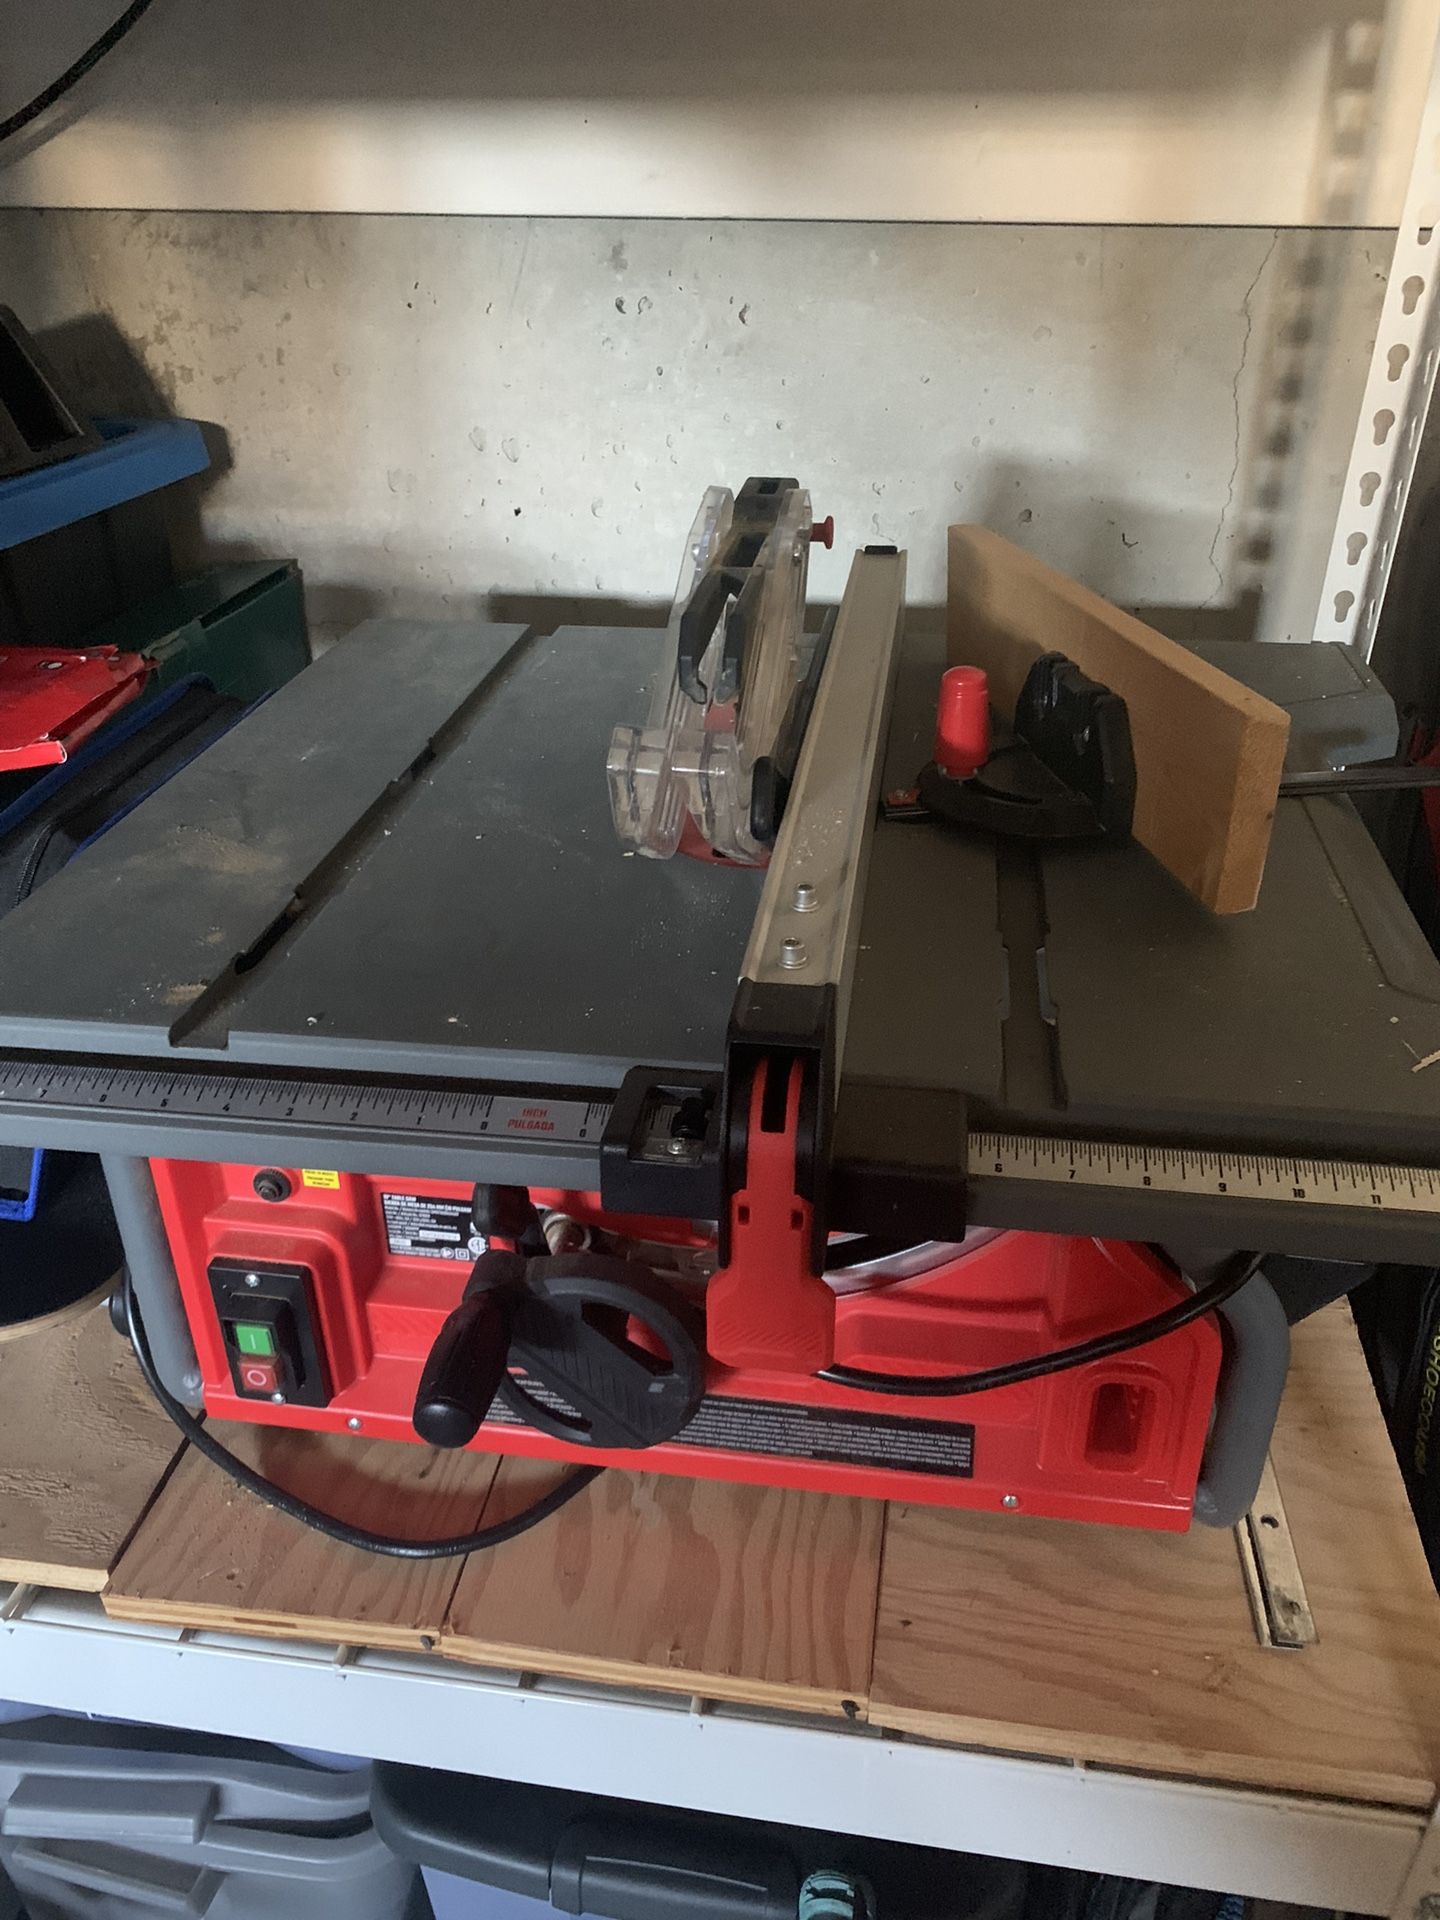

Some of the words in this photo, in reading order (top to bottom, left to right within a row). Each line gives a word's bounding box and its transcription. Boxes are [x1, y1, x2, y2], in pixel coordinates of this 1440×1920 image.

[160, 1098, 168, 1107] 5
[222, 1103, 230, 1112] 4
[285, 1107, 294, 1117] 3
[350, 1112, 358, 1121] 2
[522, 1107, 548, 1117] INCH
[507, 1119, 555, 1132] PULGADA
[994, 1163, 1003, 1173] 6
[1068, 1169, 1077, 1179] 7
[1142, 1176, 1151, 1186] 8
[1218, 1182, 1227, 1192] 9
[1292, 1188, 1306, 1199] 10
[1370, 1194, 1382, 1205] 11
